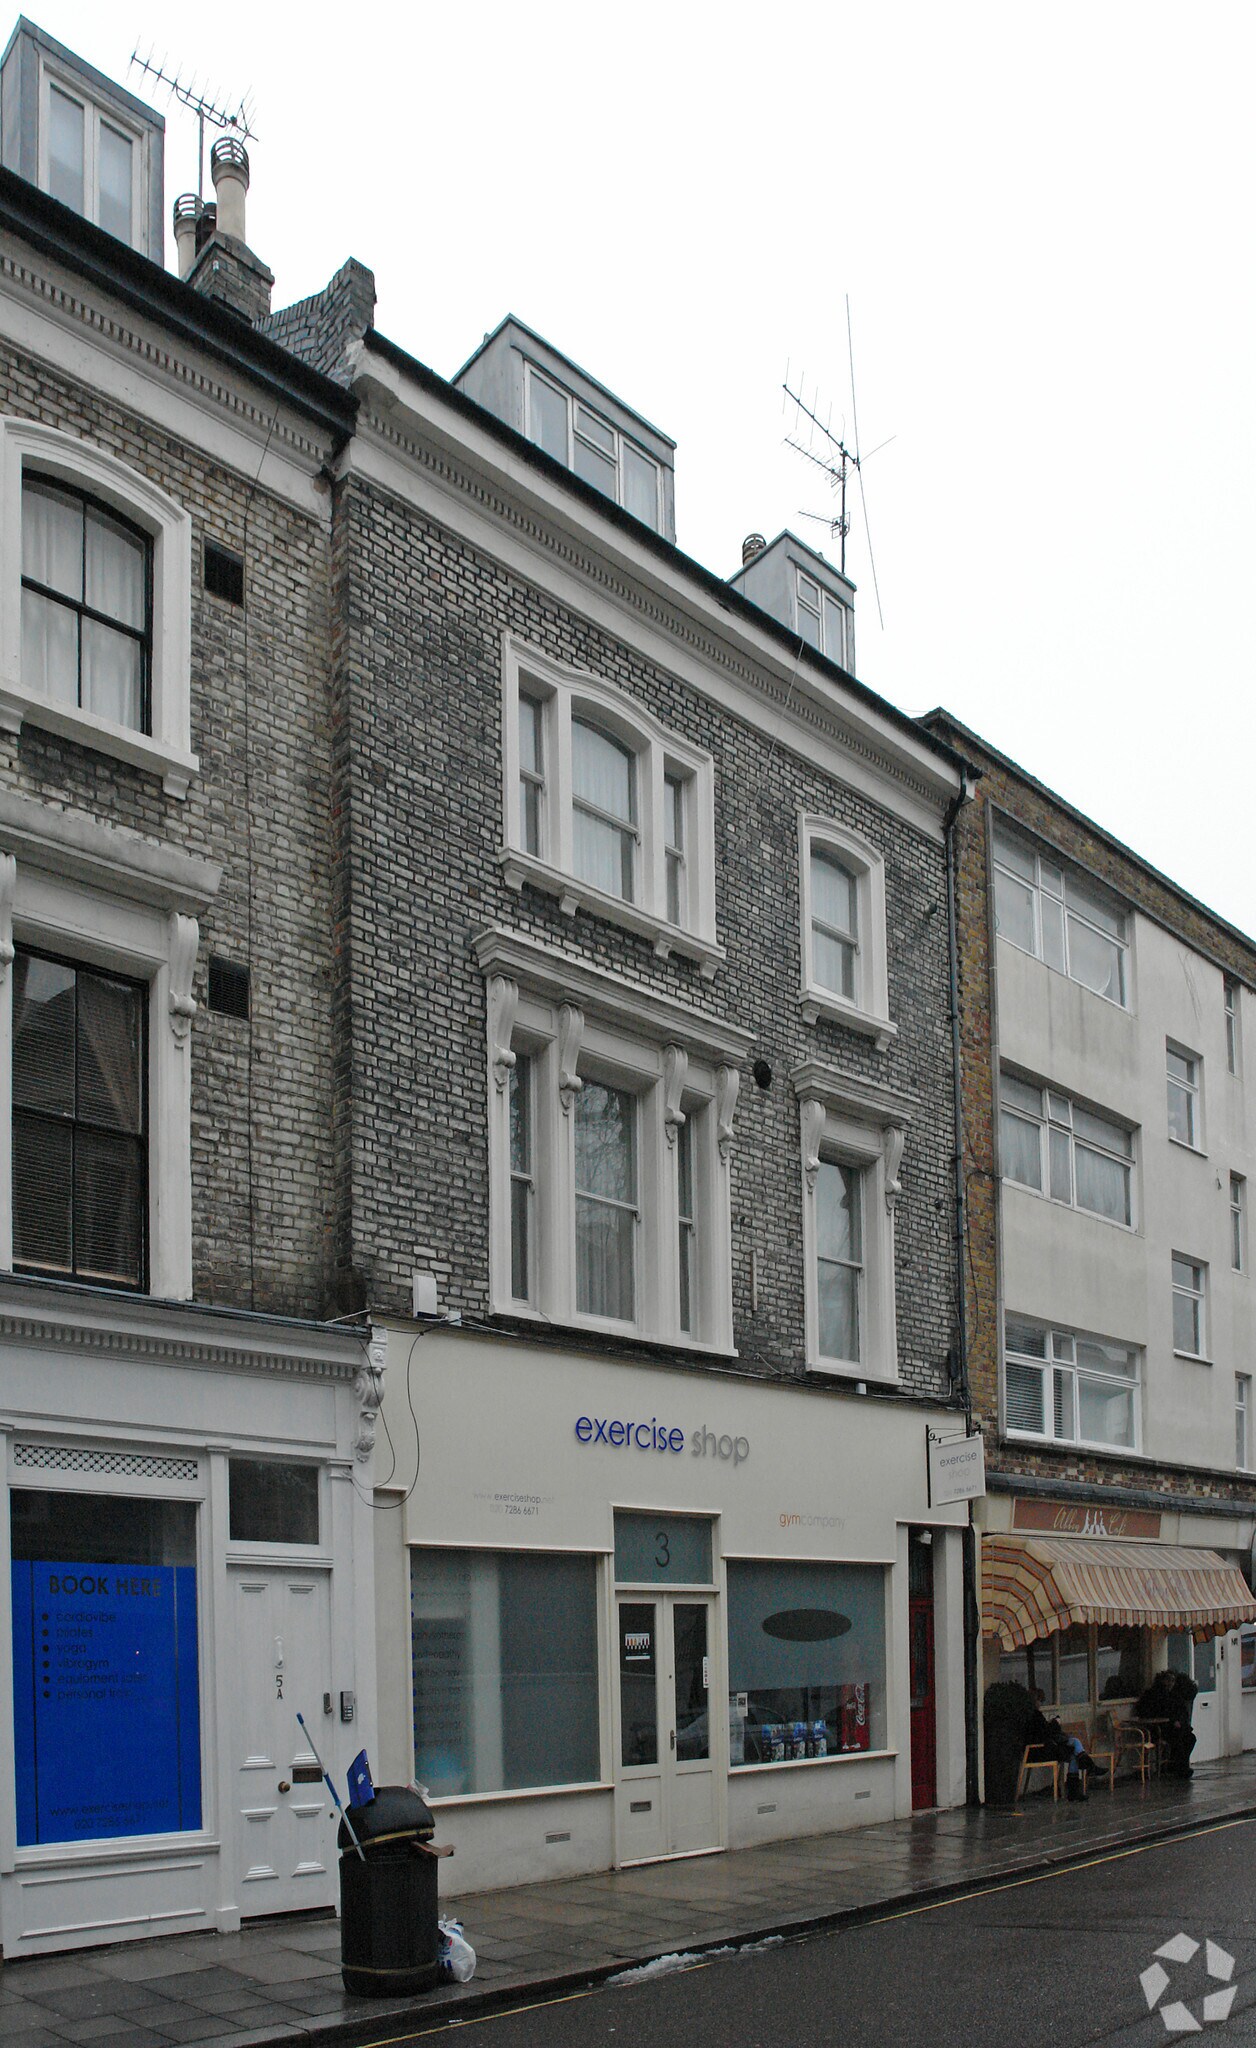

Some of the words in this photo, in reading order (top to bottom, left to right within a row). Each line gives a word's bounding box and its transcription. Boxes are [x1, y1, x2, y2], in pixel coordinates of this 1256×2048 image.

[576, 1416, 684, 1453] exercise
[691, 1423, 750, 1467] shop
[940, 1452, 977, 1467] exercise
[505, 1504, 522, 1515] 7286
[523, 1506, 539, 1516] 6671
[779, 1513, 847, 1530] gymcompany
[655, 1532, 670, 1568] 3
[49, 1575, 109, 1596] BOOK
[116, 1578, 162, 1598] HERE
[56, 1643, 87, 1656] yoga
